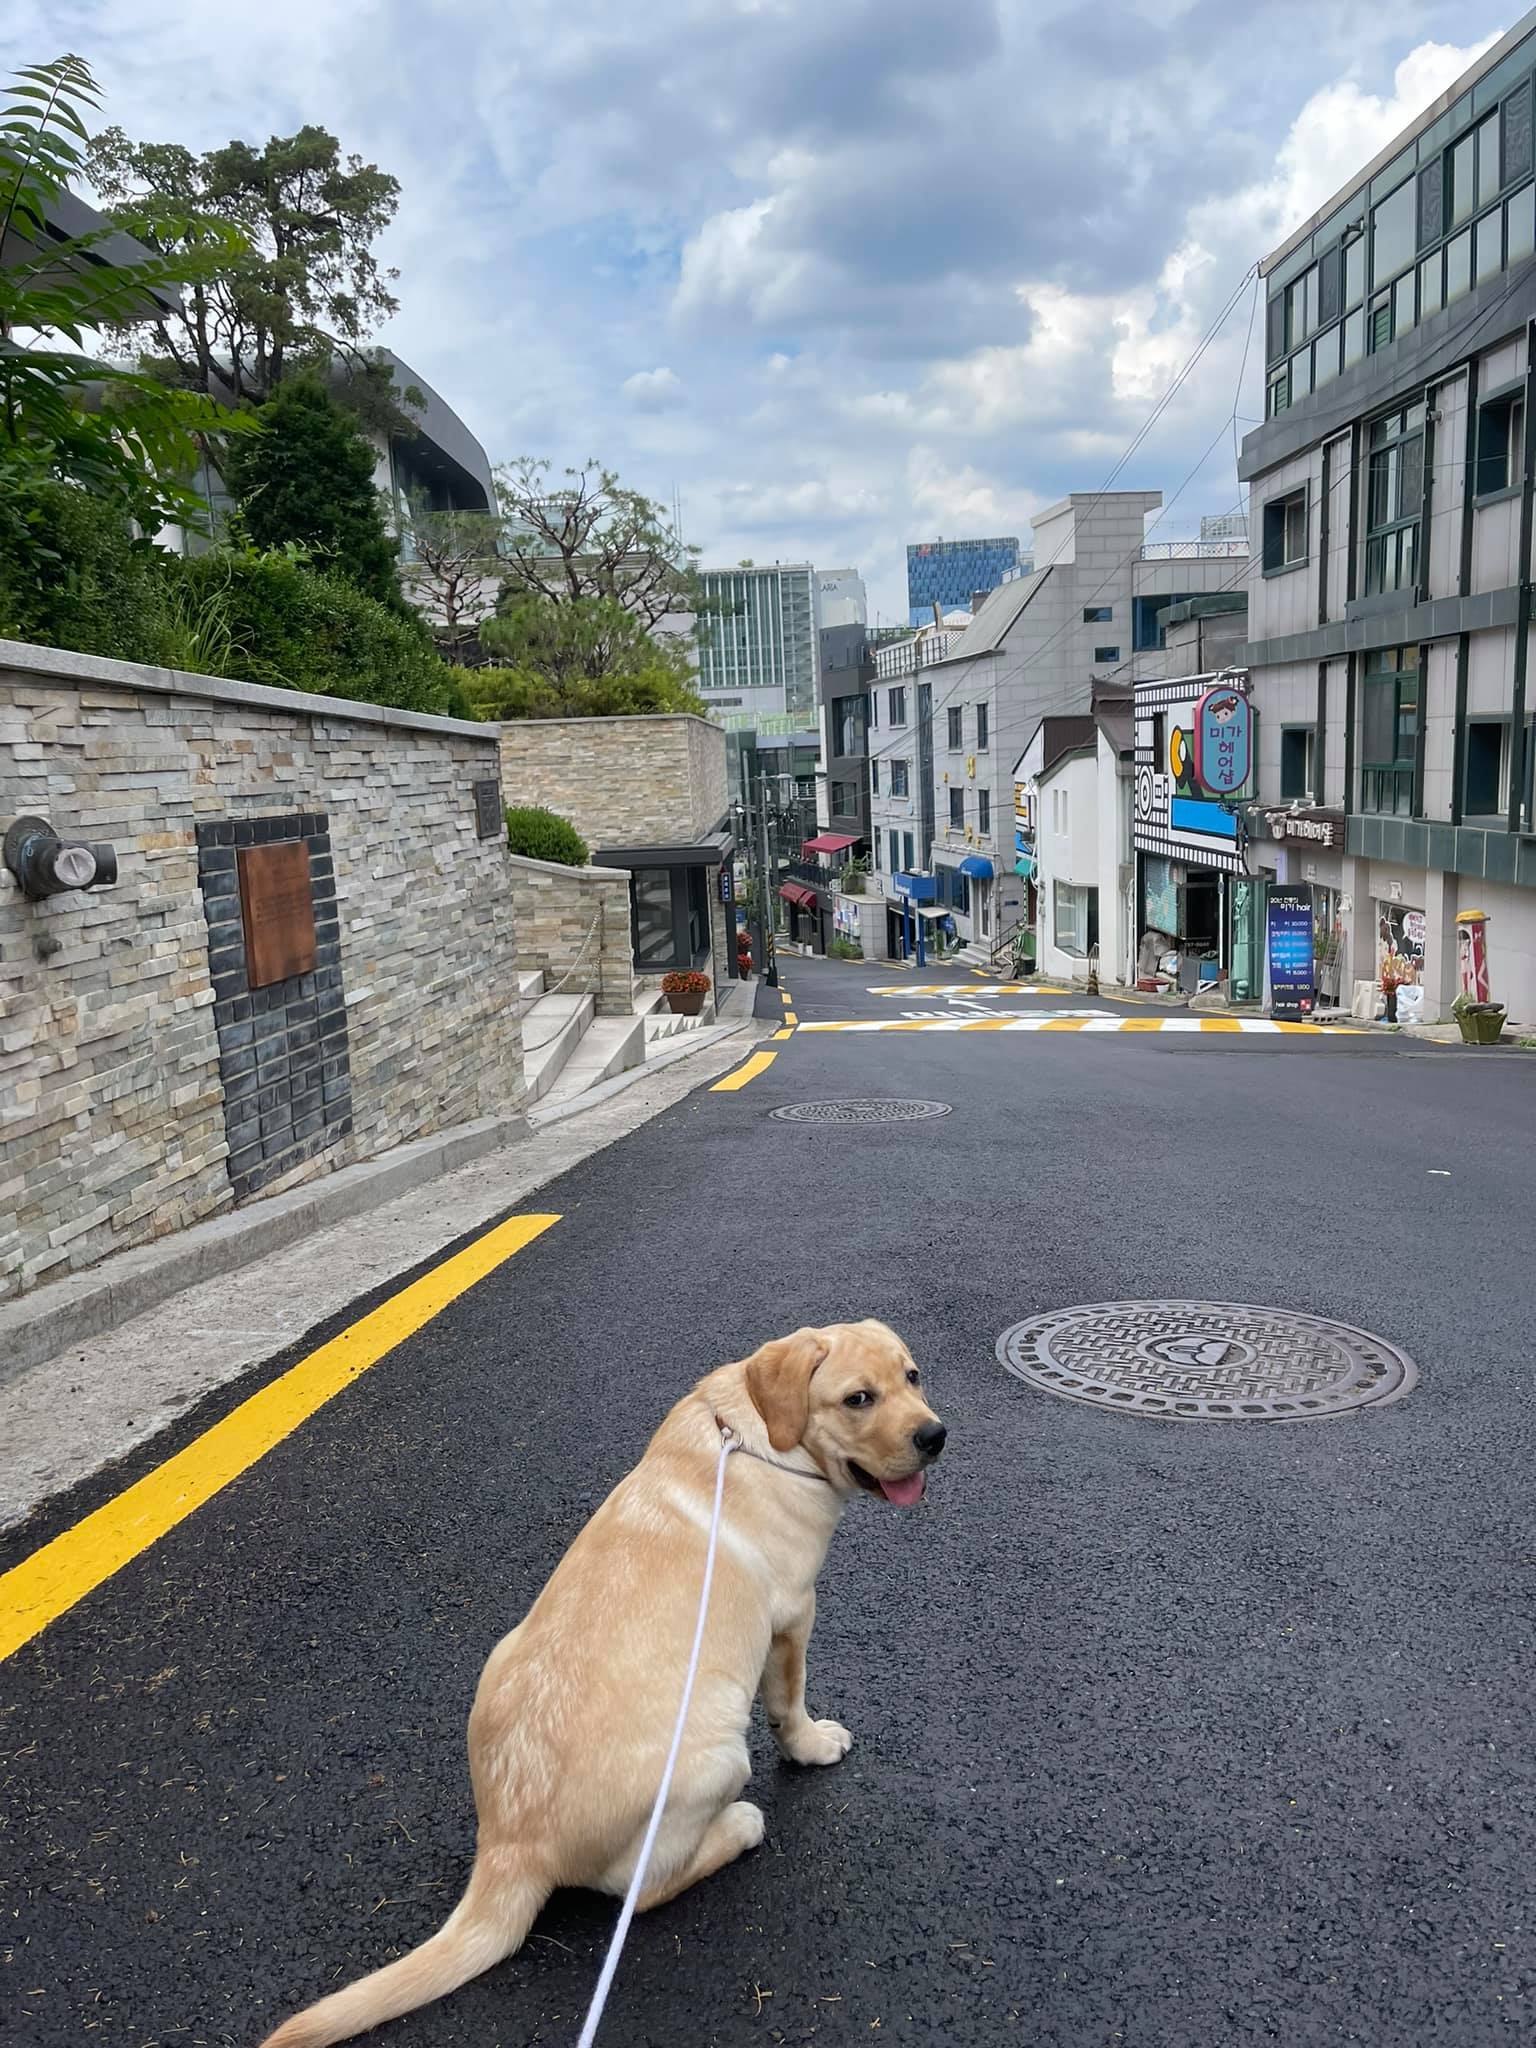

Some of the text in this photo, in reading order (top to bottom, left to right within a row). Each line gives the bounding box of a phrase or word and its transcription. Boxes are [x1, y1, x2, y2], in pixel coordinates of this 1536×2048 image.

[1209, 725, 1242, 738] 미가
[1217, 741, 1235, 785] 헤어샵
[1296, 903, 1311, 912] hair
